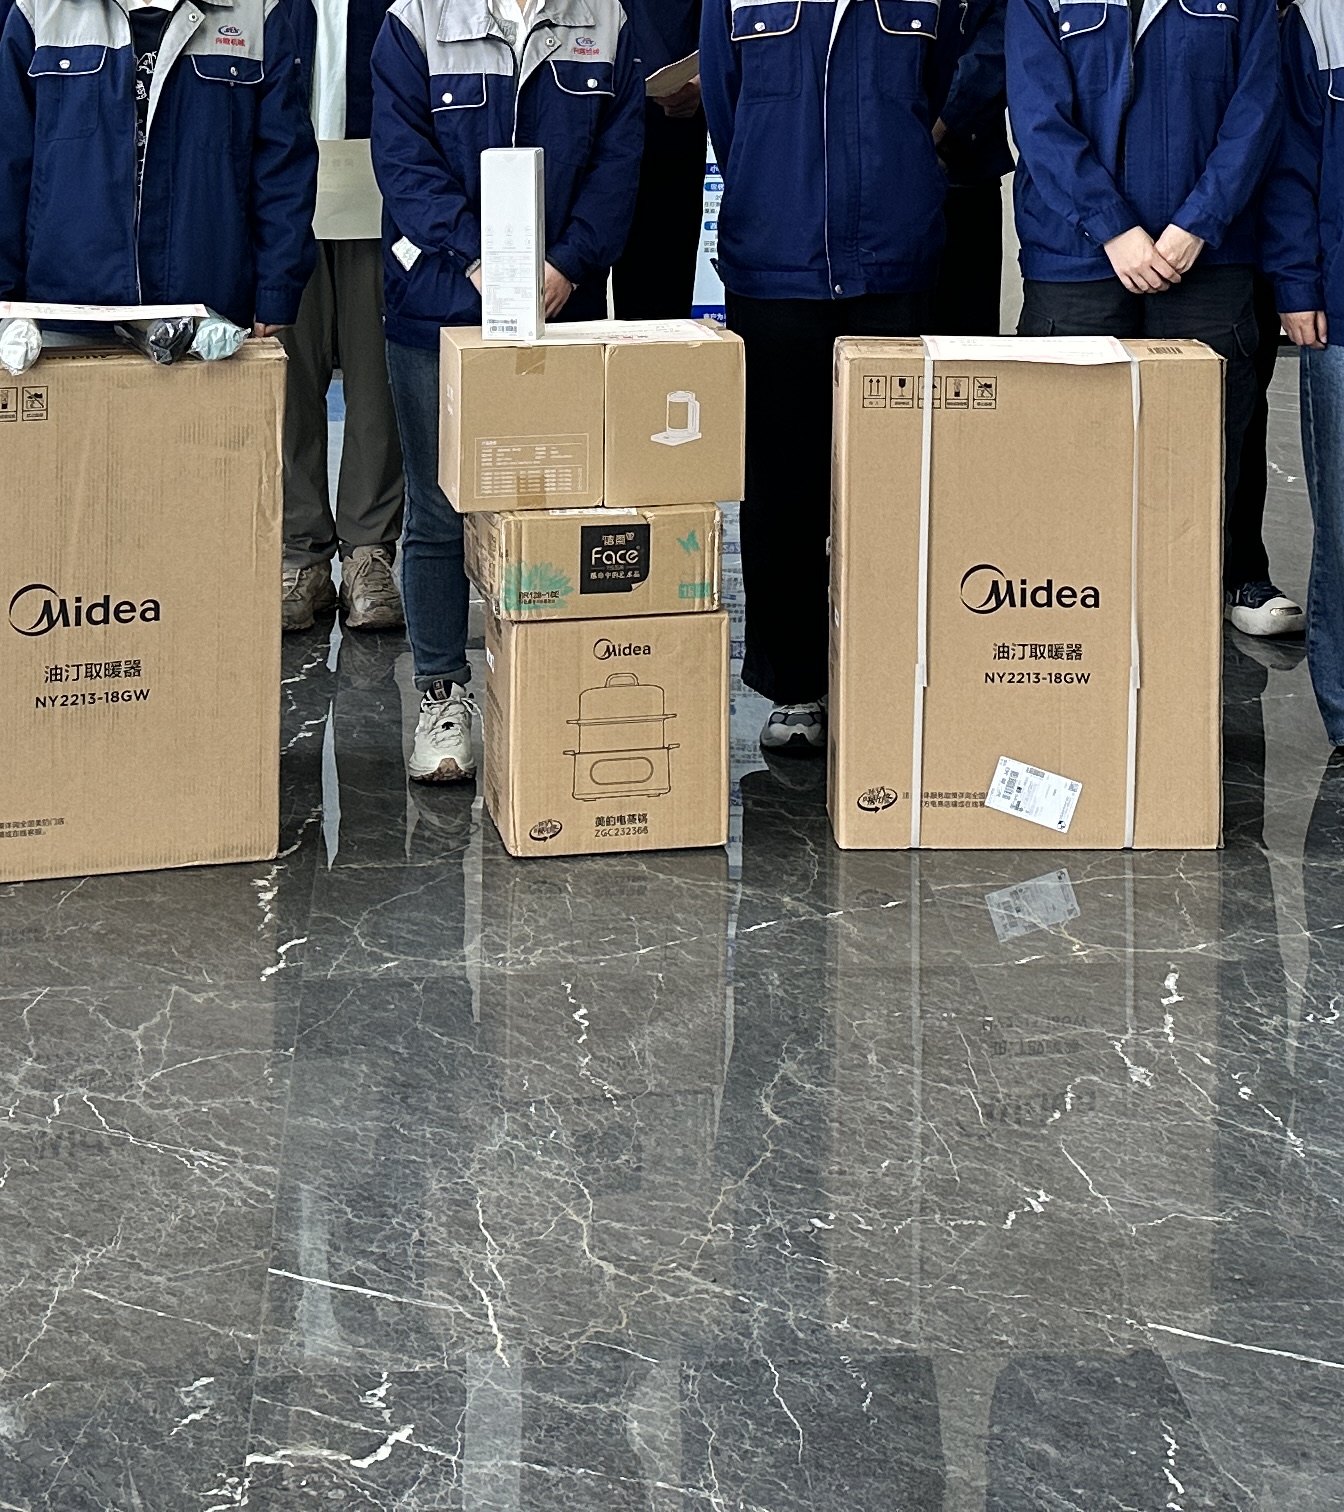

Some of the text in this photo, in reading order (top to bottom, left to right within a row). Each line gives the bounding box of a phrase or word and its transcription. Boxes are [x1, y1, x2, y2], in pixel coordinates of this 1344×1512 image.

[591, 547, 639, 566] Face
[960, 563, 1100, 615] Midea
[8, 583, 161, 637] Midea
[593, 638, 651, 660] Midea
[992, 642, 1083, 661] 油汀取暖器
[43, 659, 143, 684] 油汀取暖器
[984, 671, 1091, 685] NY2213-18GW
[35, 688, 151, 709] NY2213-18GW
